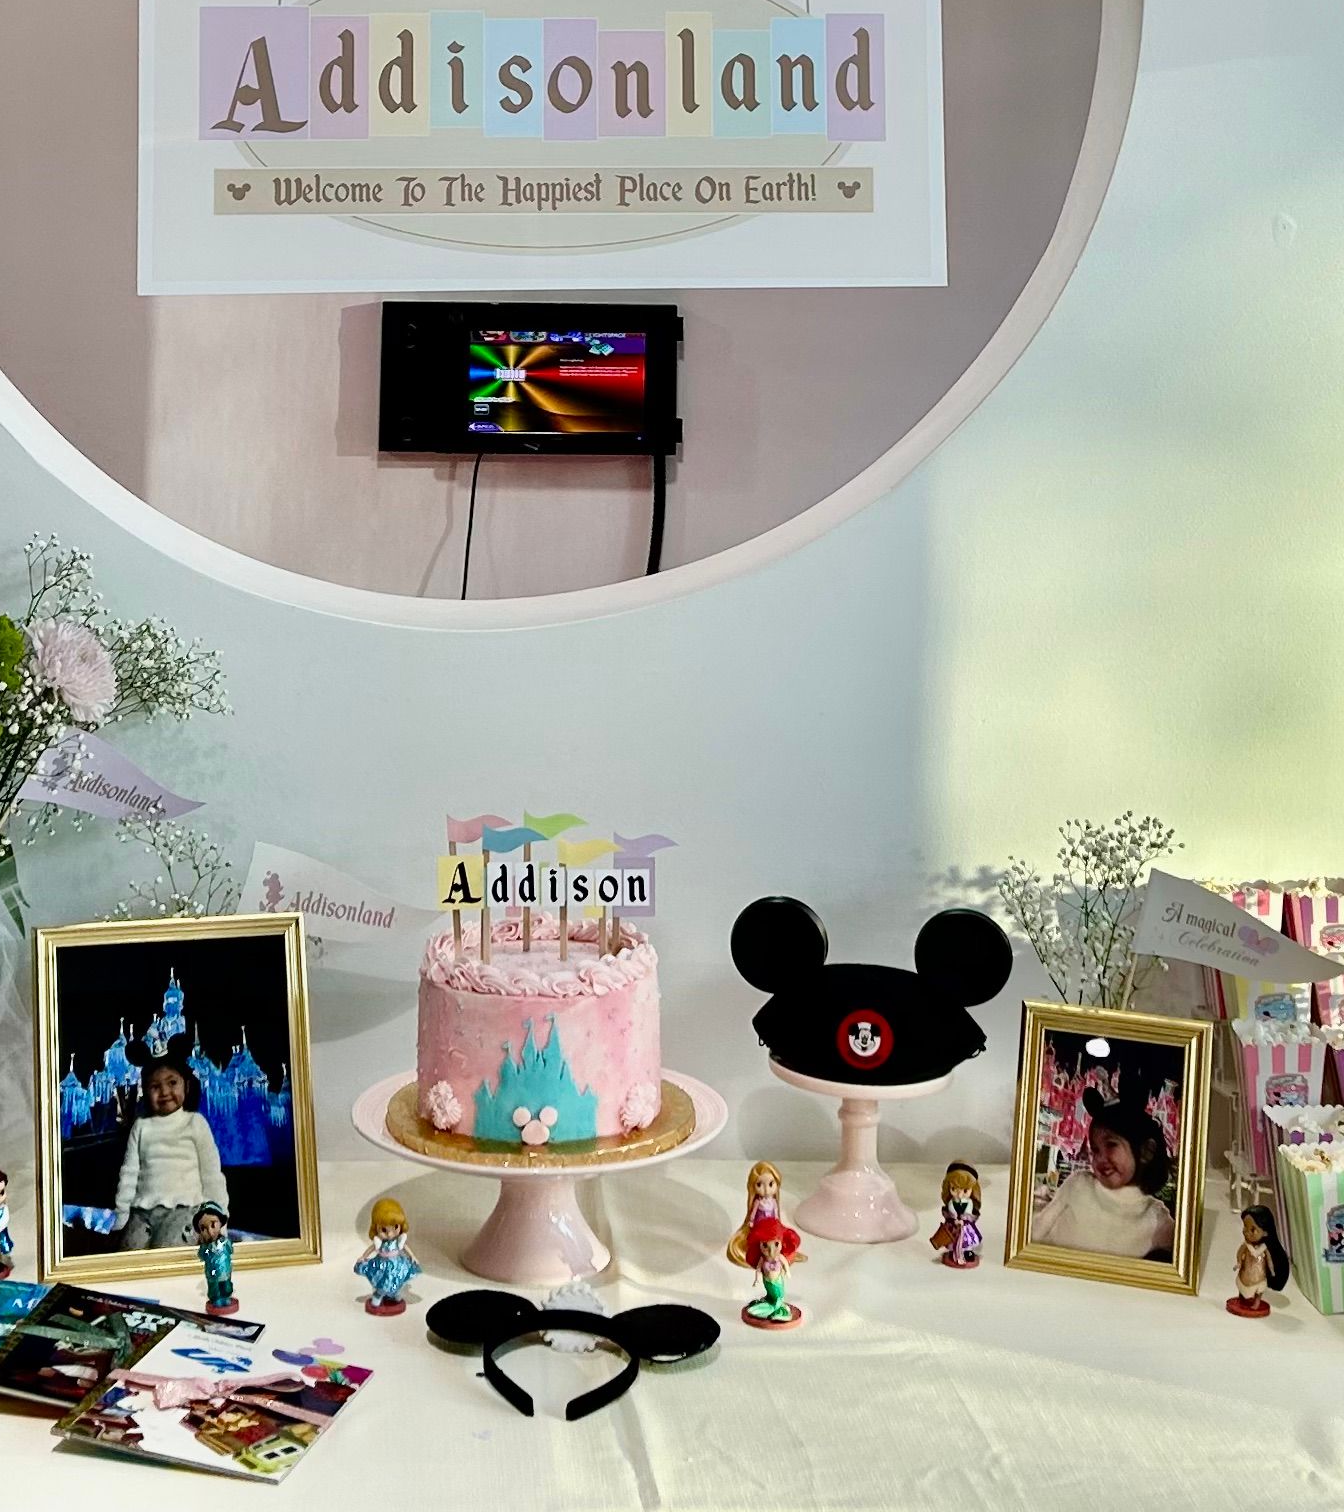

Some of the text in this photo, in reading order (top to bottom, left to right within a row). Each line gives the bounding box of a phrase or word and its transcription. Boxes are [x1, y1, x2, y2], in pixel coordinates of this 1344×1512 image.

[210, 27, 876, 134] Addisonland
[271, 172, 817, 211] Welcome To The Happiest Place On Earth!
[442, 861, 647, 904] Addison
[285, 890, 397, 929] Addisonland
[1161, 901, 1237, 939] A magical
[1177, 930, 1260, 966] Celebration
